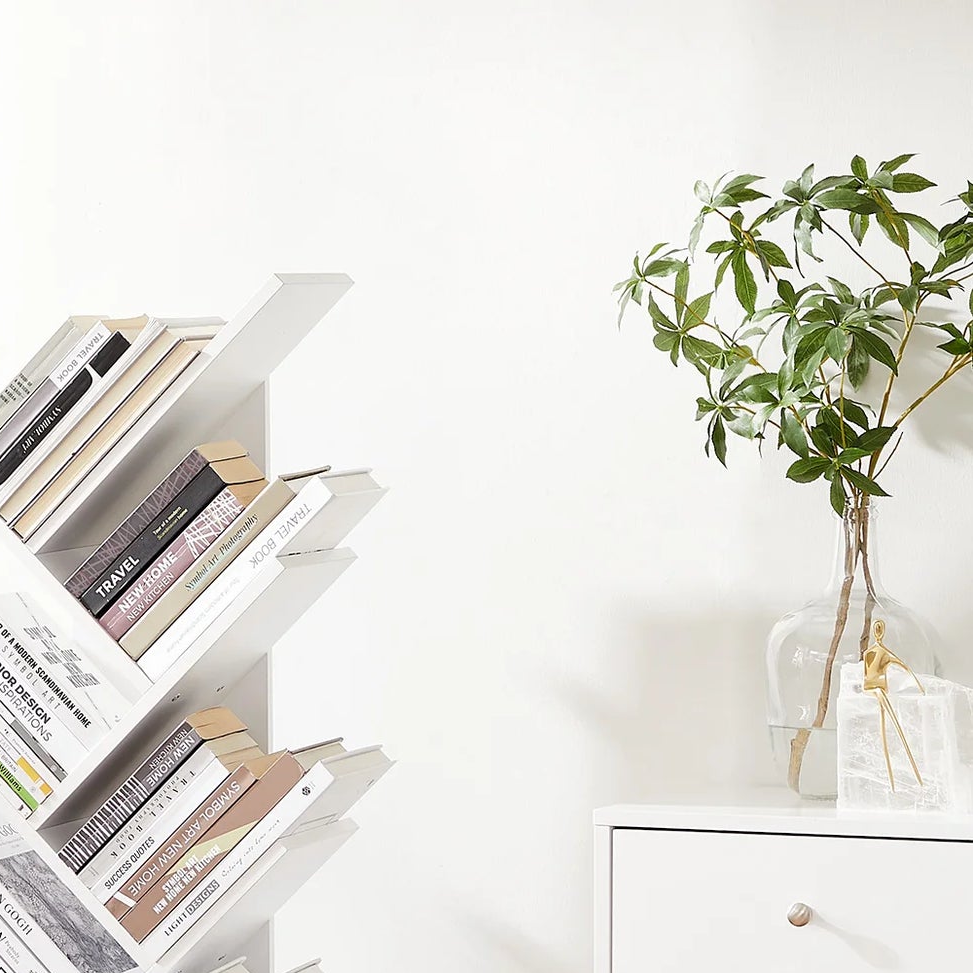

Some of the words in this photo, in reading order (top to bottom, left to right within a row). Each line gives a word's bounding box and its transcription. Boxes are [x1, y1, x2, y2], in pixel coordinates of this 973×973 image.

[77, 332, 104, 359] TRAVEL
[58, 360, 78, 382] BOOK
[274, 504, 313, 541] TRAVEL
[186, 567, 209, 592] Symbol
[208, 555, 219, 568] Art
[219, 513, 259, 555] Photography
[249, 538, 277, 569] BOOK
[96, 555, 140, 598] TRAVEL
[118, 583, 146, 613] NEW
[143, 551, 178, 589] HOME
[127, 603, 145, 622] NEW
[144, 573, 176, 604] KITCHEN
[1, 629, 12, 641] OF
[13, 642, 37, 669] MODERN
[35, 667, 75, 711] SCANDINAVIAN
[73, 709, 92, 729] HOME
[2, 646, 37, 687] SYMBOL
[42, 691, 62, 710] ART
[15, 685, 51, 724] DESIGN
[172, 728, 187, 745] NEW
[174, 736, 195, 760] NEW
[146, 759, 175, 787] HOME
[149, 744, 174, 769] KITCHEN
[149, 770, 196, 817] TRAVEL
[200, 781, 241, 822] SYMBOL
[111, 825, 143, 859] BOOK
[184, 822, 201, 843] ART
[105, 859, 132, 889] SUCCESS
[131, 836, 155, 864] QUOTES
[158, 841, 184, 867] NEW
[128, 865, 160, 896] HOME
[153, 899, 168, 914] NEW
[165, 881, 187, 902] HOME
[184, 870, 197, 885] NEW
[162, 863, 188, 893] SYMBOL
[185, 855, 200, 869] ART
[4, 903, 33, 935] GOGH
[164, 912, 188, 936] LIGHT
[186, 880, 219, 915] DESIGNS
